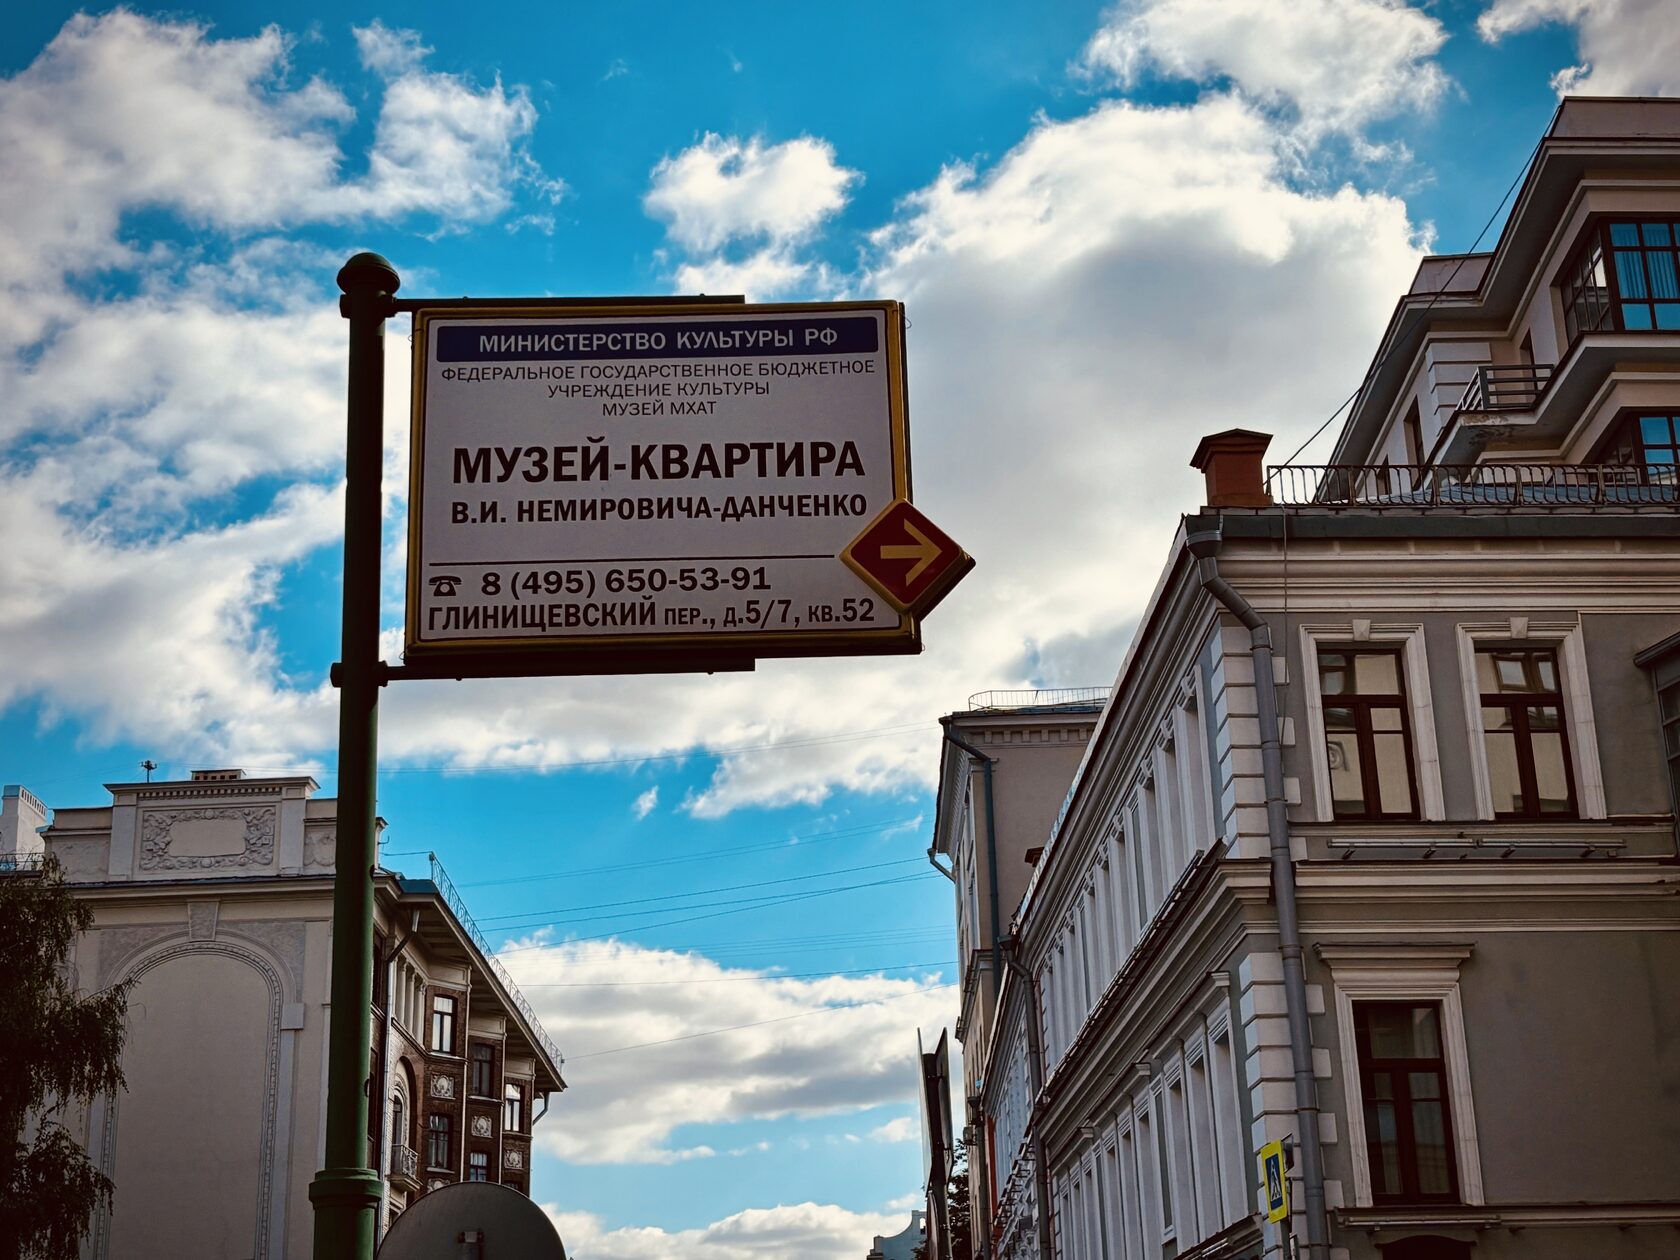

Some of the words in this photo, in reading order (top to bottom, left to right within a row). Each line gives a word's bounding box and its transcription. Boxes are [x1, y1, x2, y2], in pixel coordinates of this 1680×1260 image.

[479, 332, 667, 353] МИНИСТЕРСТВО
[677, 329, 795, 349] КУЛЬТУРЫ
[804, 327, 839, 347] РФ
[441, 365, 575, 383] ФЕДЕРАЛЬНОЕ
[580, 362, 753, 381] ГОСУДАРСТВЕННОЕ
[758, 359, 876, 378] БЮДЖЕТНОЕ
[547, 382, 671, 400] УЧРЕЖДЕНИЕ
[677, 381, 770, 397] КУЛЬТУРЫ
[602, 398, 664, 417] МУЗЕЙ
[670, 400, 717, 415] МХАТ
[453, 436, 866, 484] МУЗЕЙ-КВАРТИРА
[452, 500, 507, 524] В.И.
[517, 494, 867, 523] НЕМИРОВИЧА-ДАНЧЕНКО
[481, 571, 502, 596] 8
[510, 569, 596, 600] (495)
[605, 566, 771, 593] 650-53-91
[428, 594, 656, 632] ГЛИНИЩЕВСКИЙ
